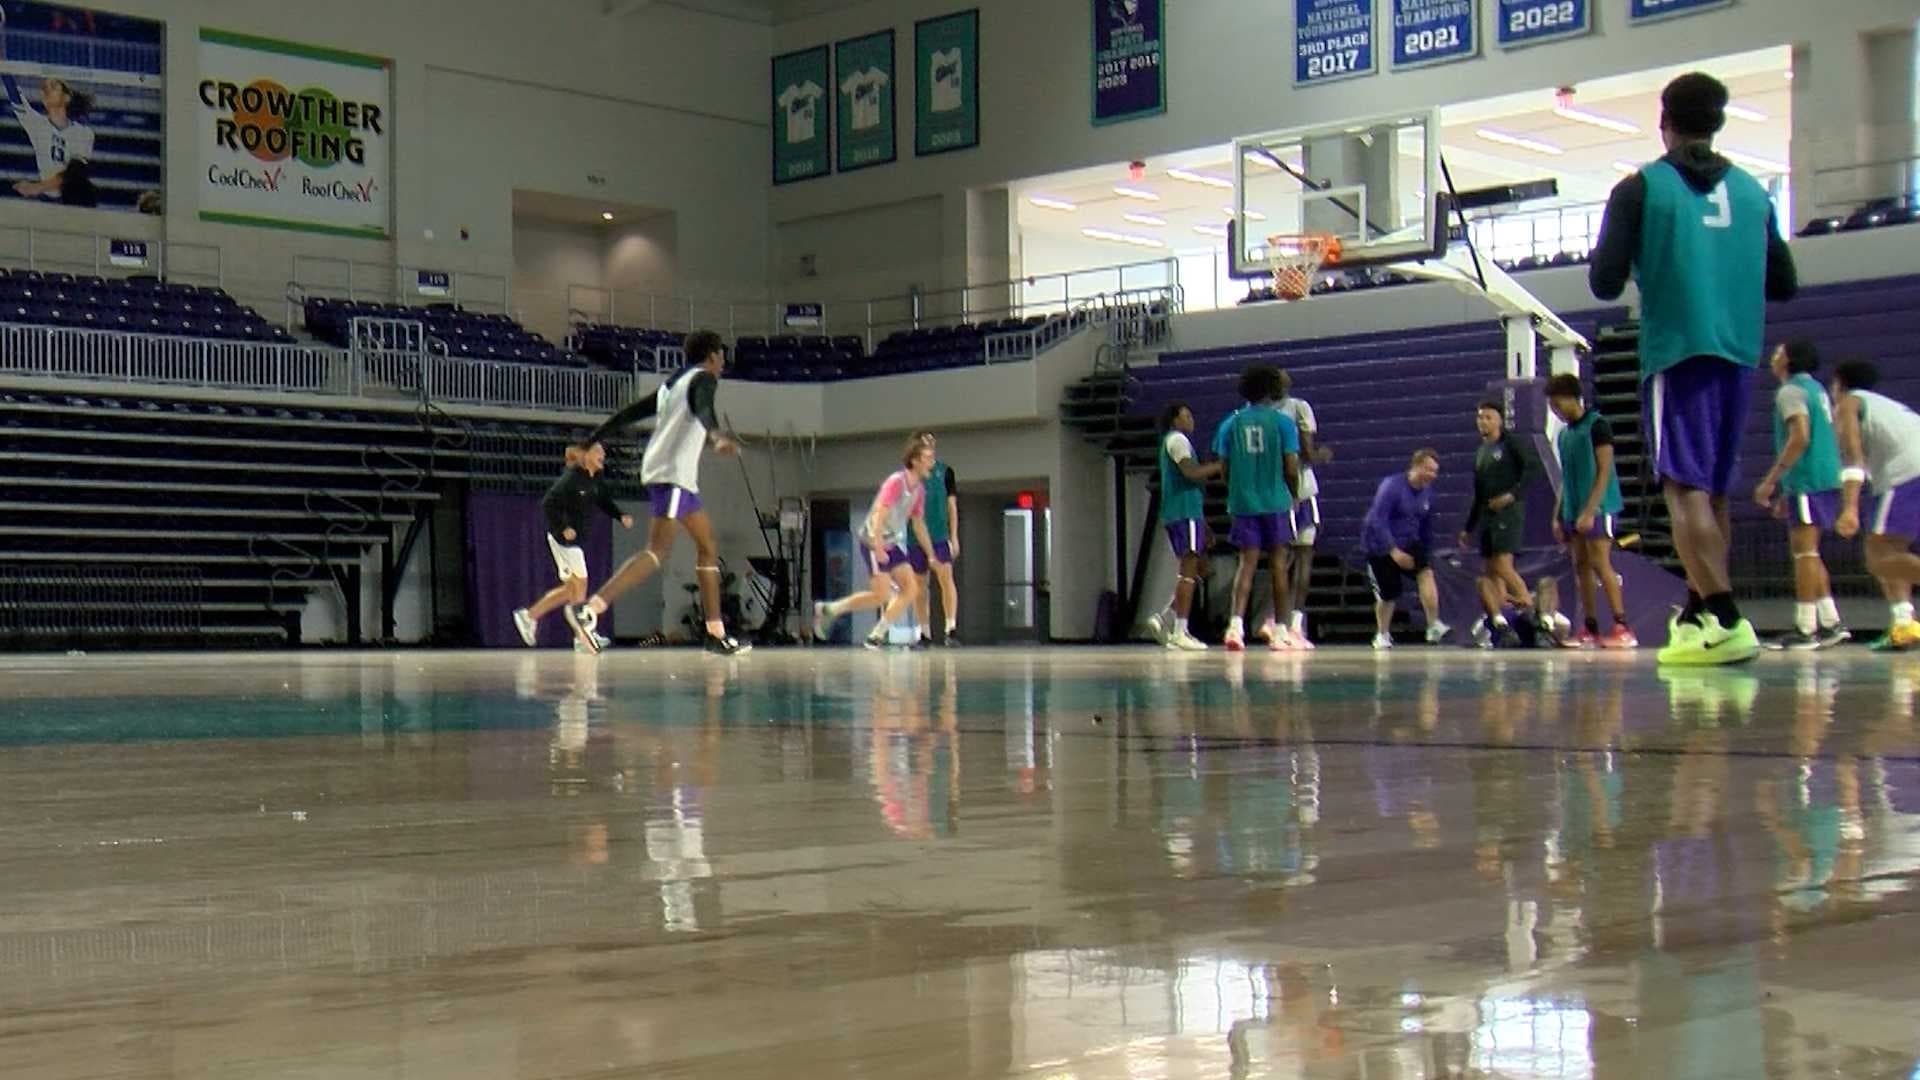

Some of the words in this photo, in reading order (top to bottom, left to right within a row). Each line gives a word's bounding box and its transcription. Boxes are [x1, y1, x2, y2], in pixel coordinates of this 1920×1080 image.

[1298, 14, 1370, 39] TOURNAMENT
[1307, 4, 1360, 24] NATIONAL
[1395, 2, 1470, 27] CHAMPIONS
[1509, 7, 1575, 32] 2022
[1299, 41, 1325, 56] 3RD
[1327, 31, 1369, 50] PLACE
[1405, 25, 1460, 54] 2021
[1308, 50, 1360, 77] 2017
[199, 79, 383, 135] CROWTHER
[216, 118, 365, 166] ROOFING
